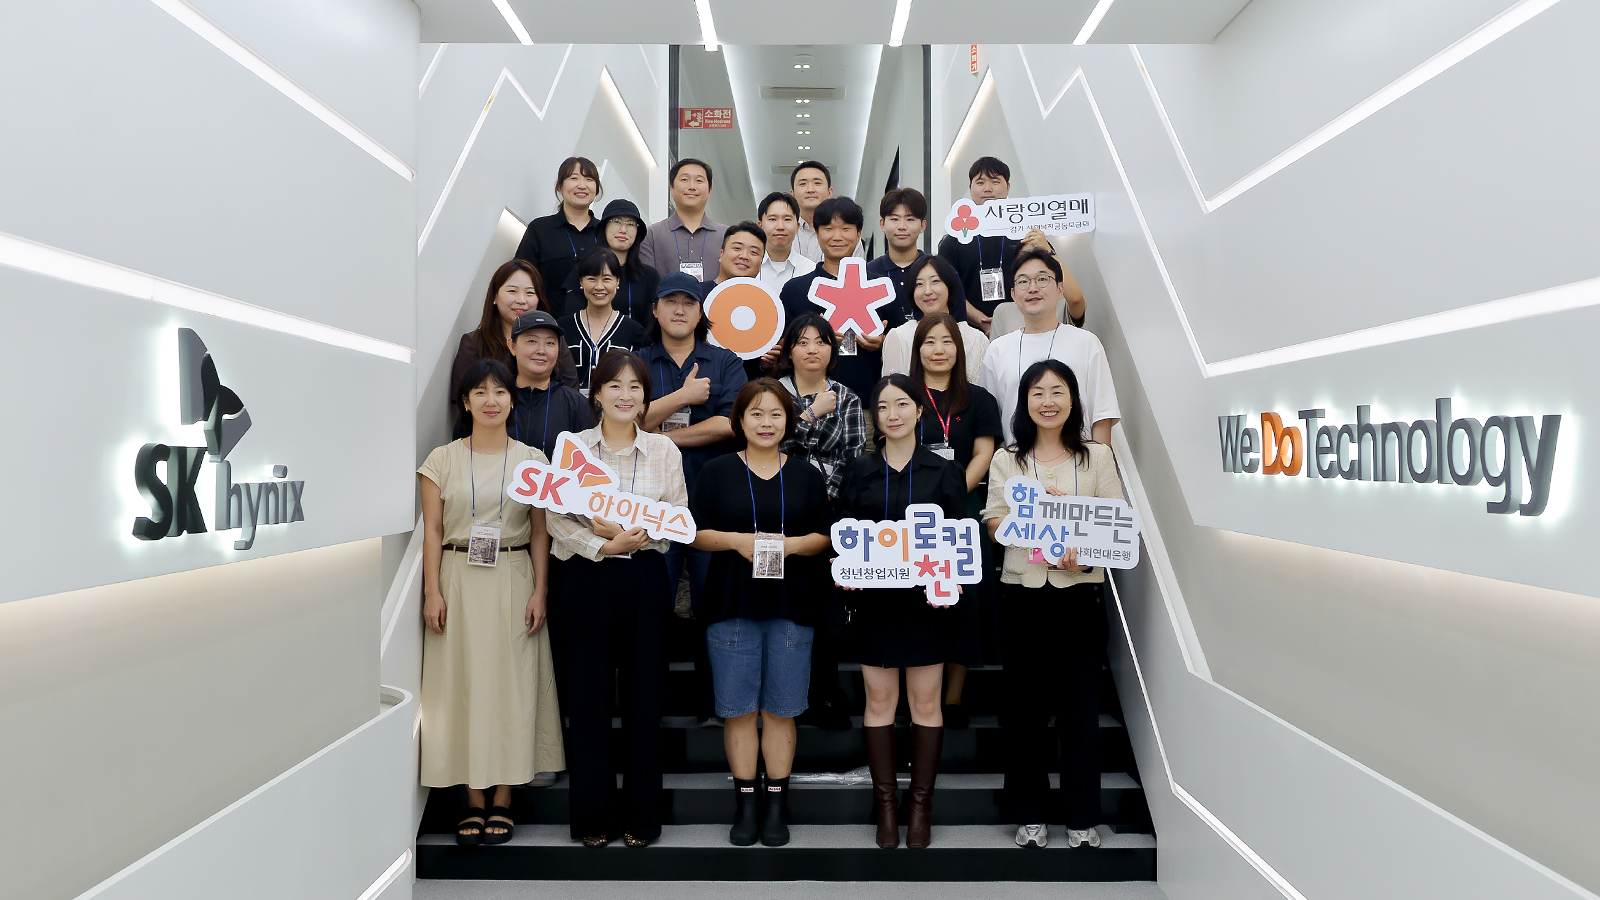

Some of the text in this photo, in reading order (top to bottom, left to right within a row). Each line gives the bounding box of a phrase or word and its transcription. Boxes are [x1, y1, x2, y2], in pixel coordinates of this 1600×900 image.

[704, 109, 731, 118] 소화전
[985, 199, 1089, 224] 사랑의열매
[1218, 398, 1562, 517] We Do Technology
[132, 443, 208, 541] SK
[215, 460, 305, 550] hynix
[515, 467, 570, 506] SK
[588, 491, 688, 537] 하이닉스
[1012, 483, 1133, 544] 함께만드는
[839, 512, 975, 576] 하이로컬
[1003, 521, 1070, 557] 세상
[839, 567, 910, 580] 청년창업지원
[914, 554, 951, 597] 천
